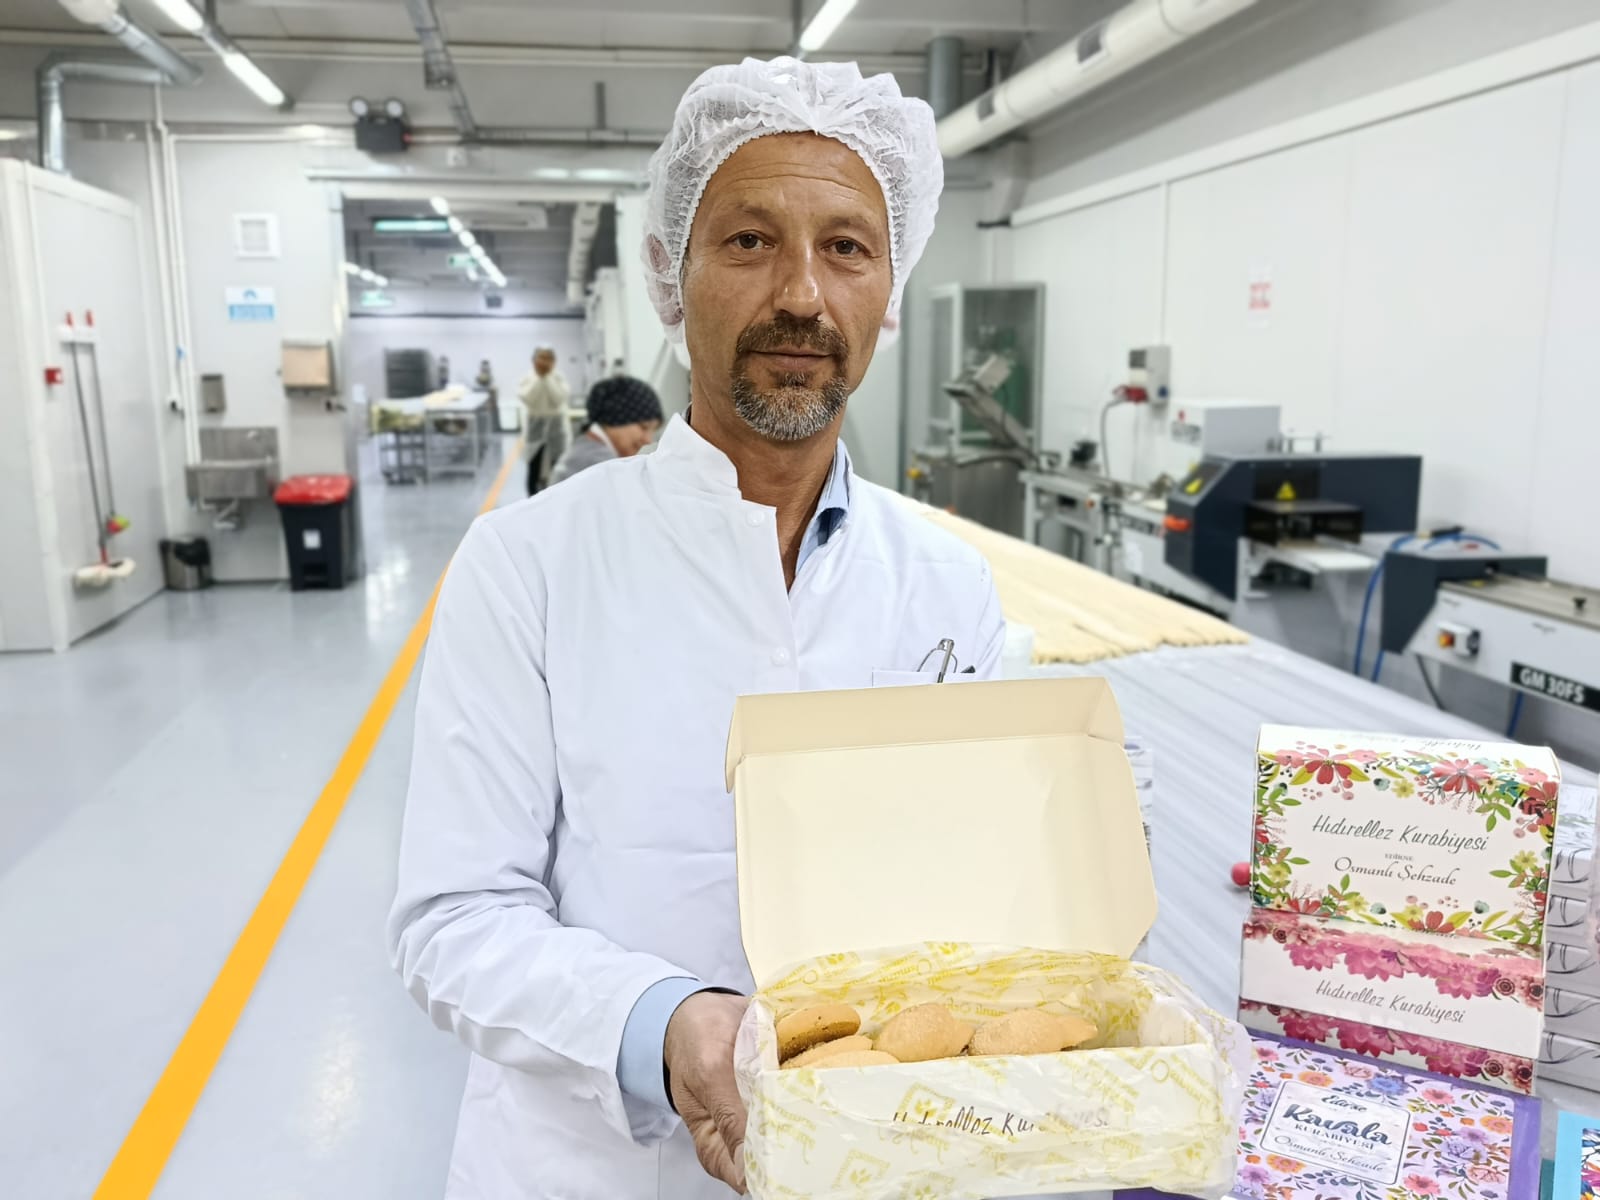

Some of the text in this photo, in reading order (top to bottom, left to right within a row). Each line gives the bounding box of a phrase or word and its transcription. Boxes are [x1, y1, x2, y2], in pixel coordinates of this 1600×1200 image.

[1519, 667, 1585, 704] GM 30FS
[1399, 825, 1489, 854] Kurabiyesi
[1388, 994, 1466, 1024] Kurabiyesi
[1282, 1104, 1392, 1145] Kavala
